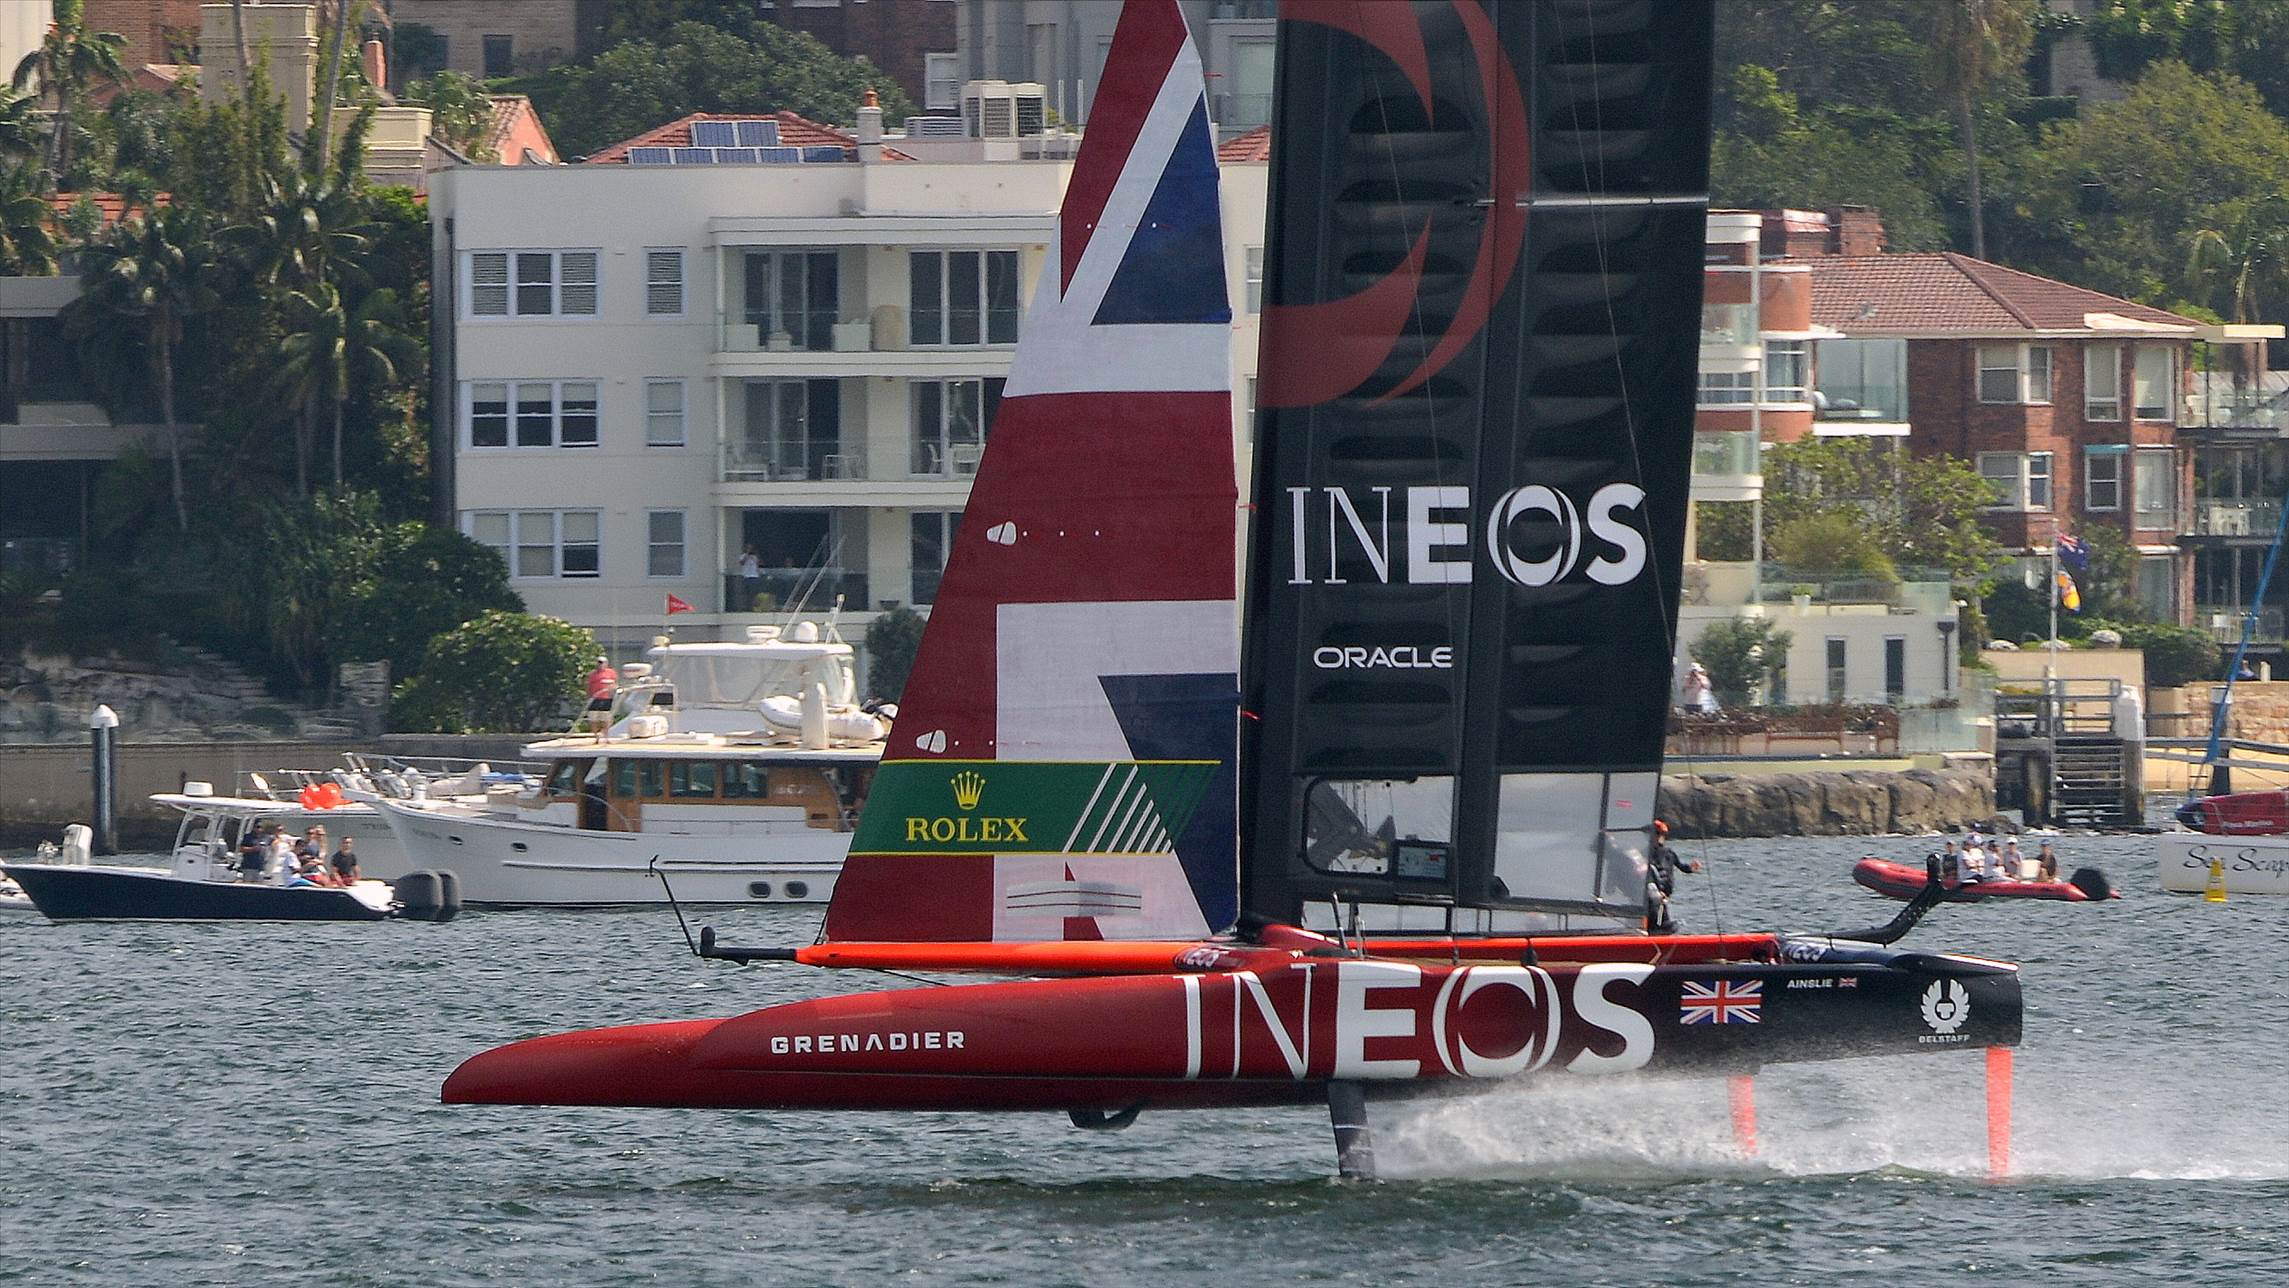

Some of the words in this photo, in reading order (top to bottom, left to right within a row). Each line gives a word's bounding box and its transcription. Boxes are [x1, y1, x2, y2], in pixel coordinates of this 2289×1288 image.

[1286, 482, 1648, 587] INEOS
[1313, 646, 1454, 668] ORACLE
[905, 817, 1029, 842] ROLEX
[1787, 979, 1833, 989] AINSLIE
[1172, 960, 1656, 1080] INEOS
[771, 1031, 965, 1054] GRENADIER
